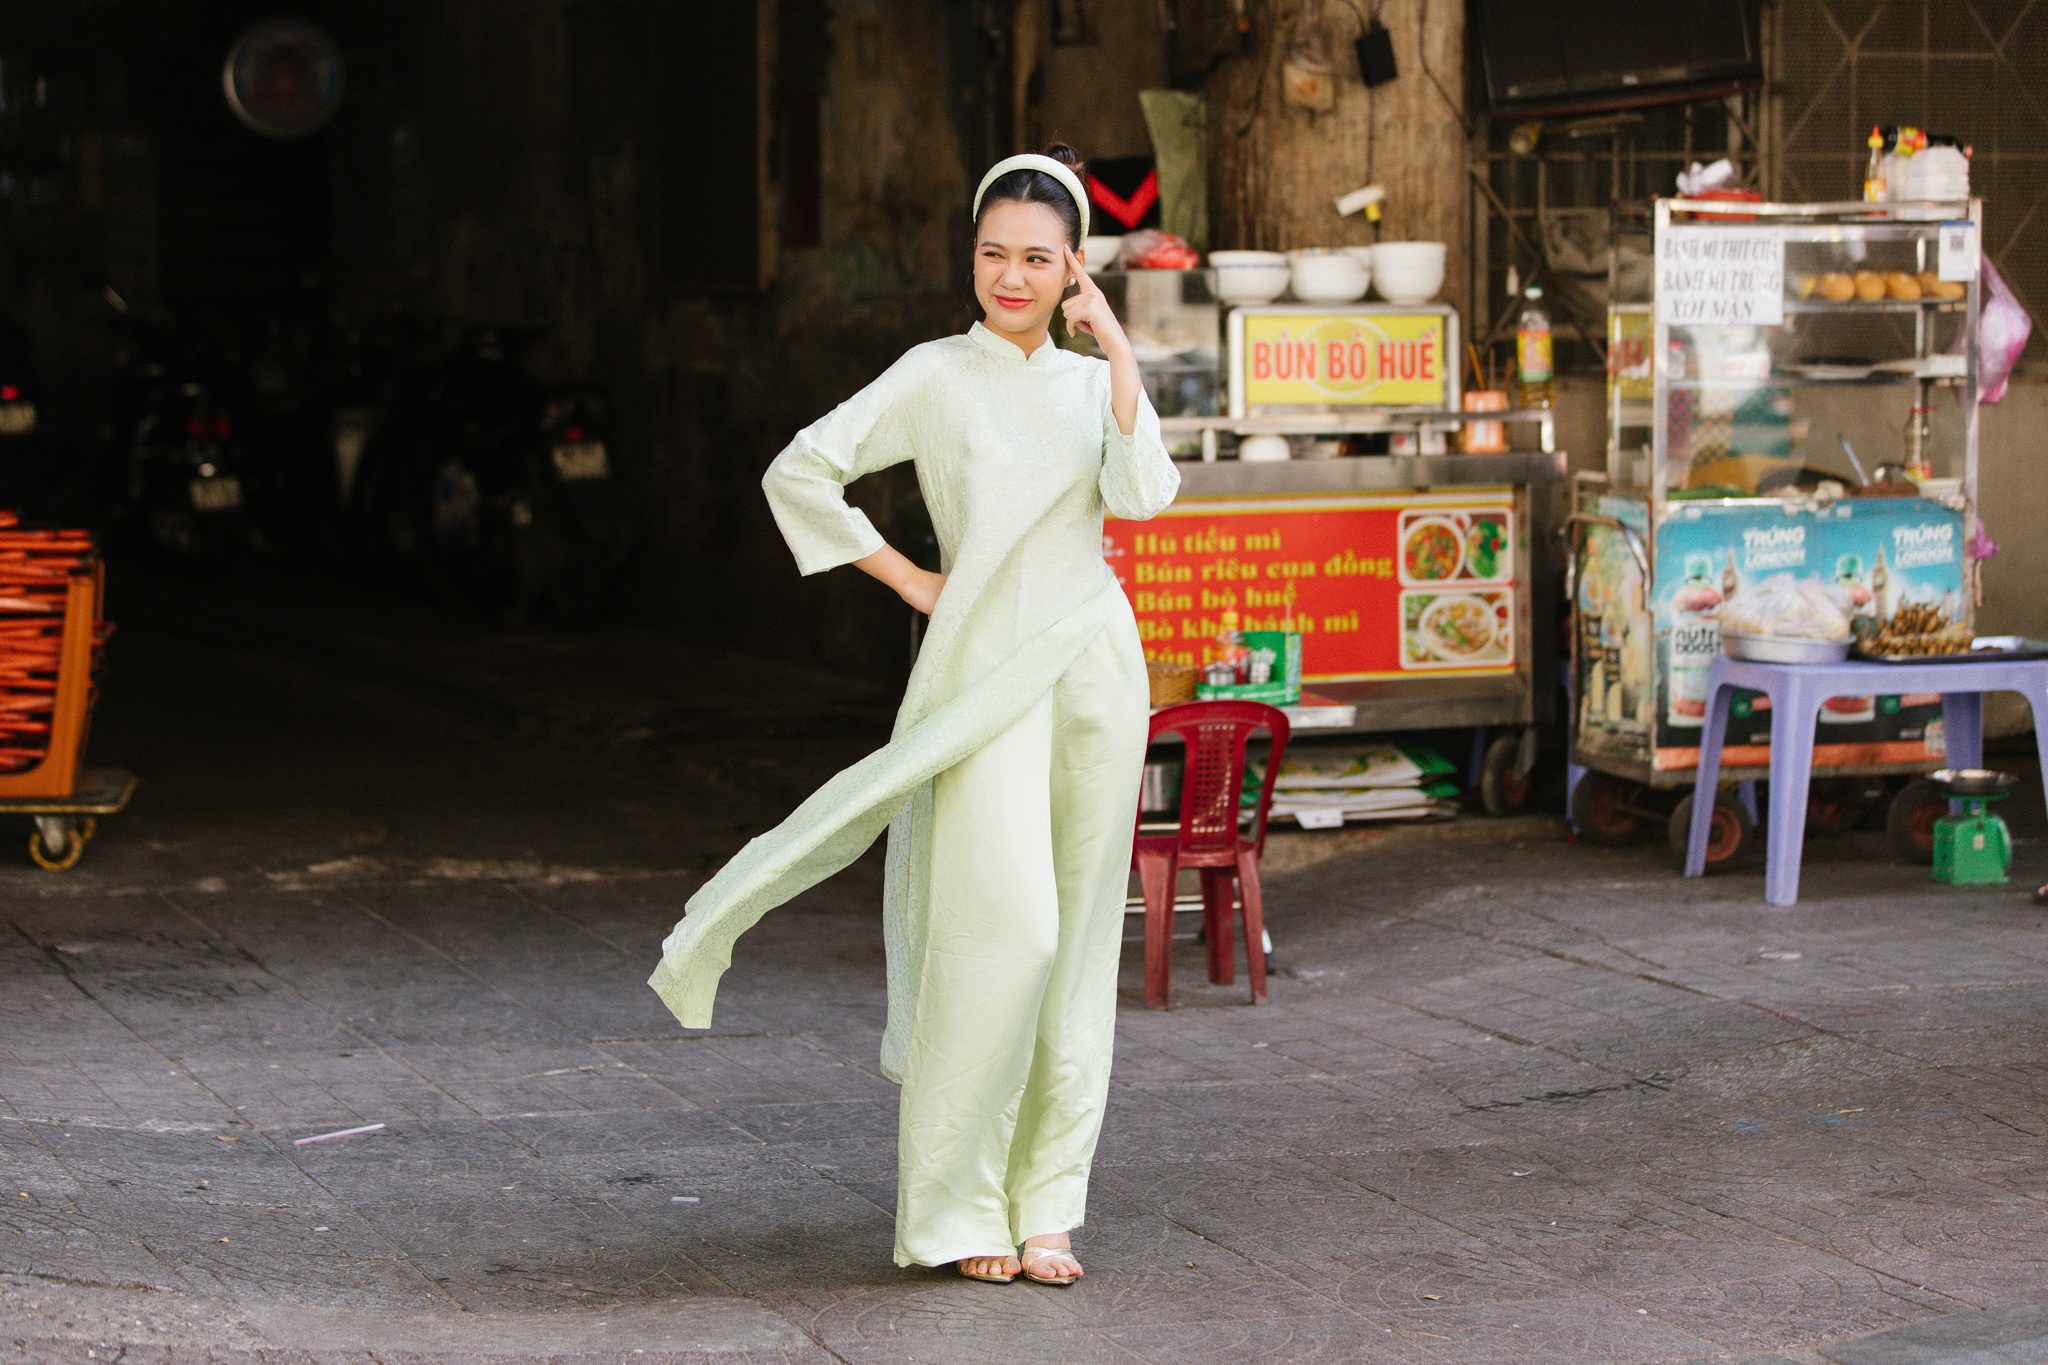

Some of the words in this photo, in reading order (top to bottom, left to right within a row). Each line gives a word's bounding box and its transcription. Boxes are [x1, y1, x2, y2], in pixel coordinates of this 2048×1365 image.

[1253, 330, 1316, 381] BÚN
[1327, 328, 1366, 380] BÒ
[1377, 325, 1438, 380] HUẾ
[1183, 525, 1237, 554] tiếu
[1244, 528, 1281, 551] mì
[1134, 560, 1192, 584] Bún
[1202, 557, 1258, 582] riêu
[1266, 560, 1316, 579] cua
[1323, 548, 1394, 580] đồng
[1135, 589, 1193, 613] Bún
[1201, 587, 1238, 610] bò
[1244, 580, 1297, 608] huế
[1137, 618, 1174, 641] Bò
[1244, 612, 1315, 634] bánh
[1323, 609, 1359, 632] mì
